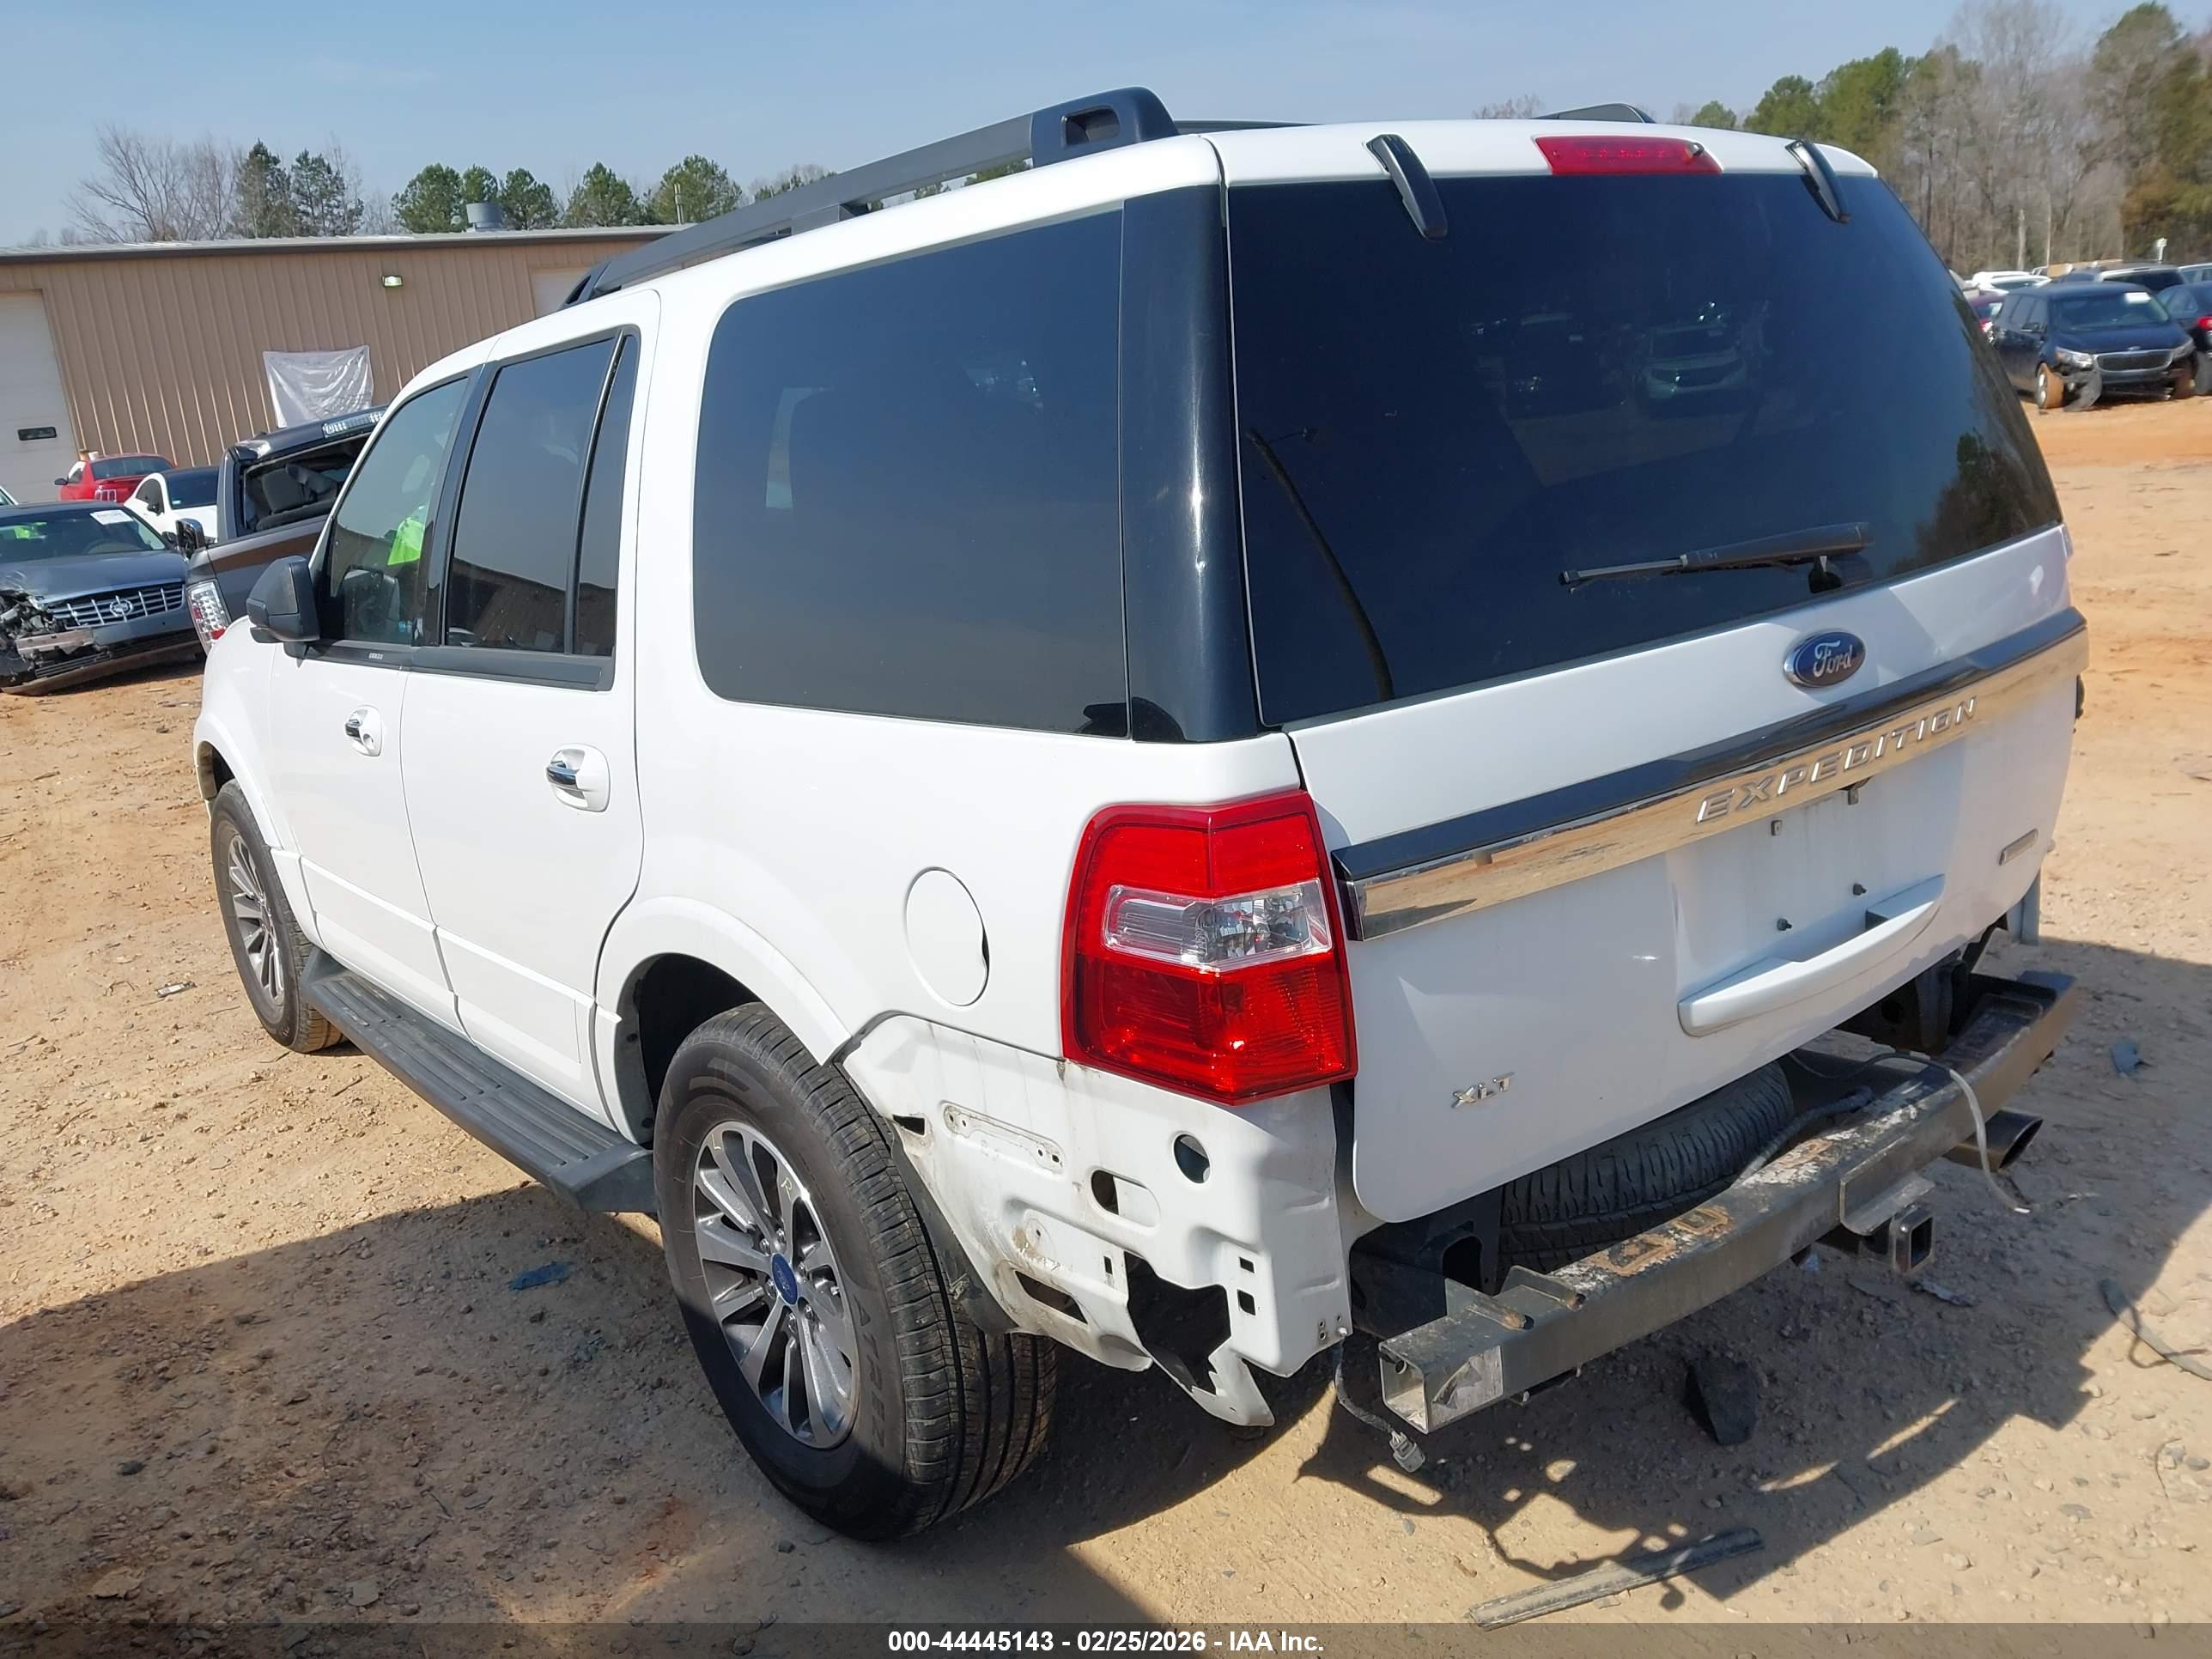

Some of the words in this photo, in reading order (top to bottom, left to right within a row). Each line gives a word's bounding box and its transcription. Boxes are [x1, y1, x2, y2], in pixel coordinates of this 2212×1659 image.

[1813, 640, 1854, 678] Ford
[1696, 696, 1977, 824] EXPEDITION
[1451, 1071, 1516, 1109] XLT
